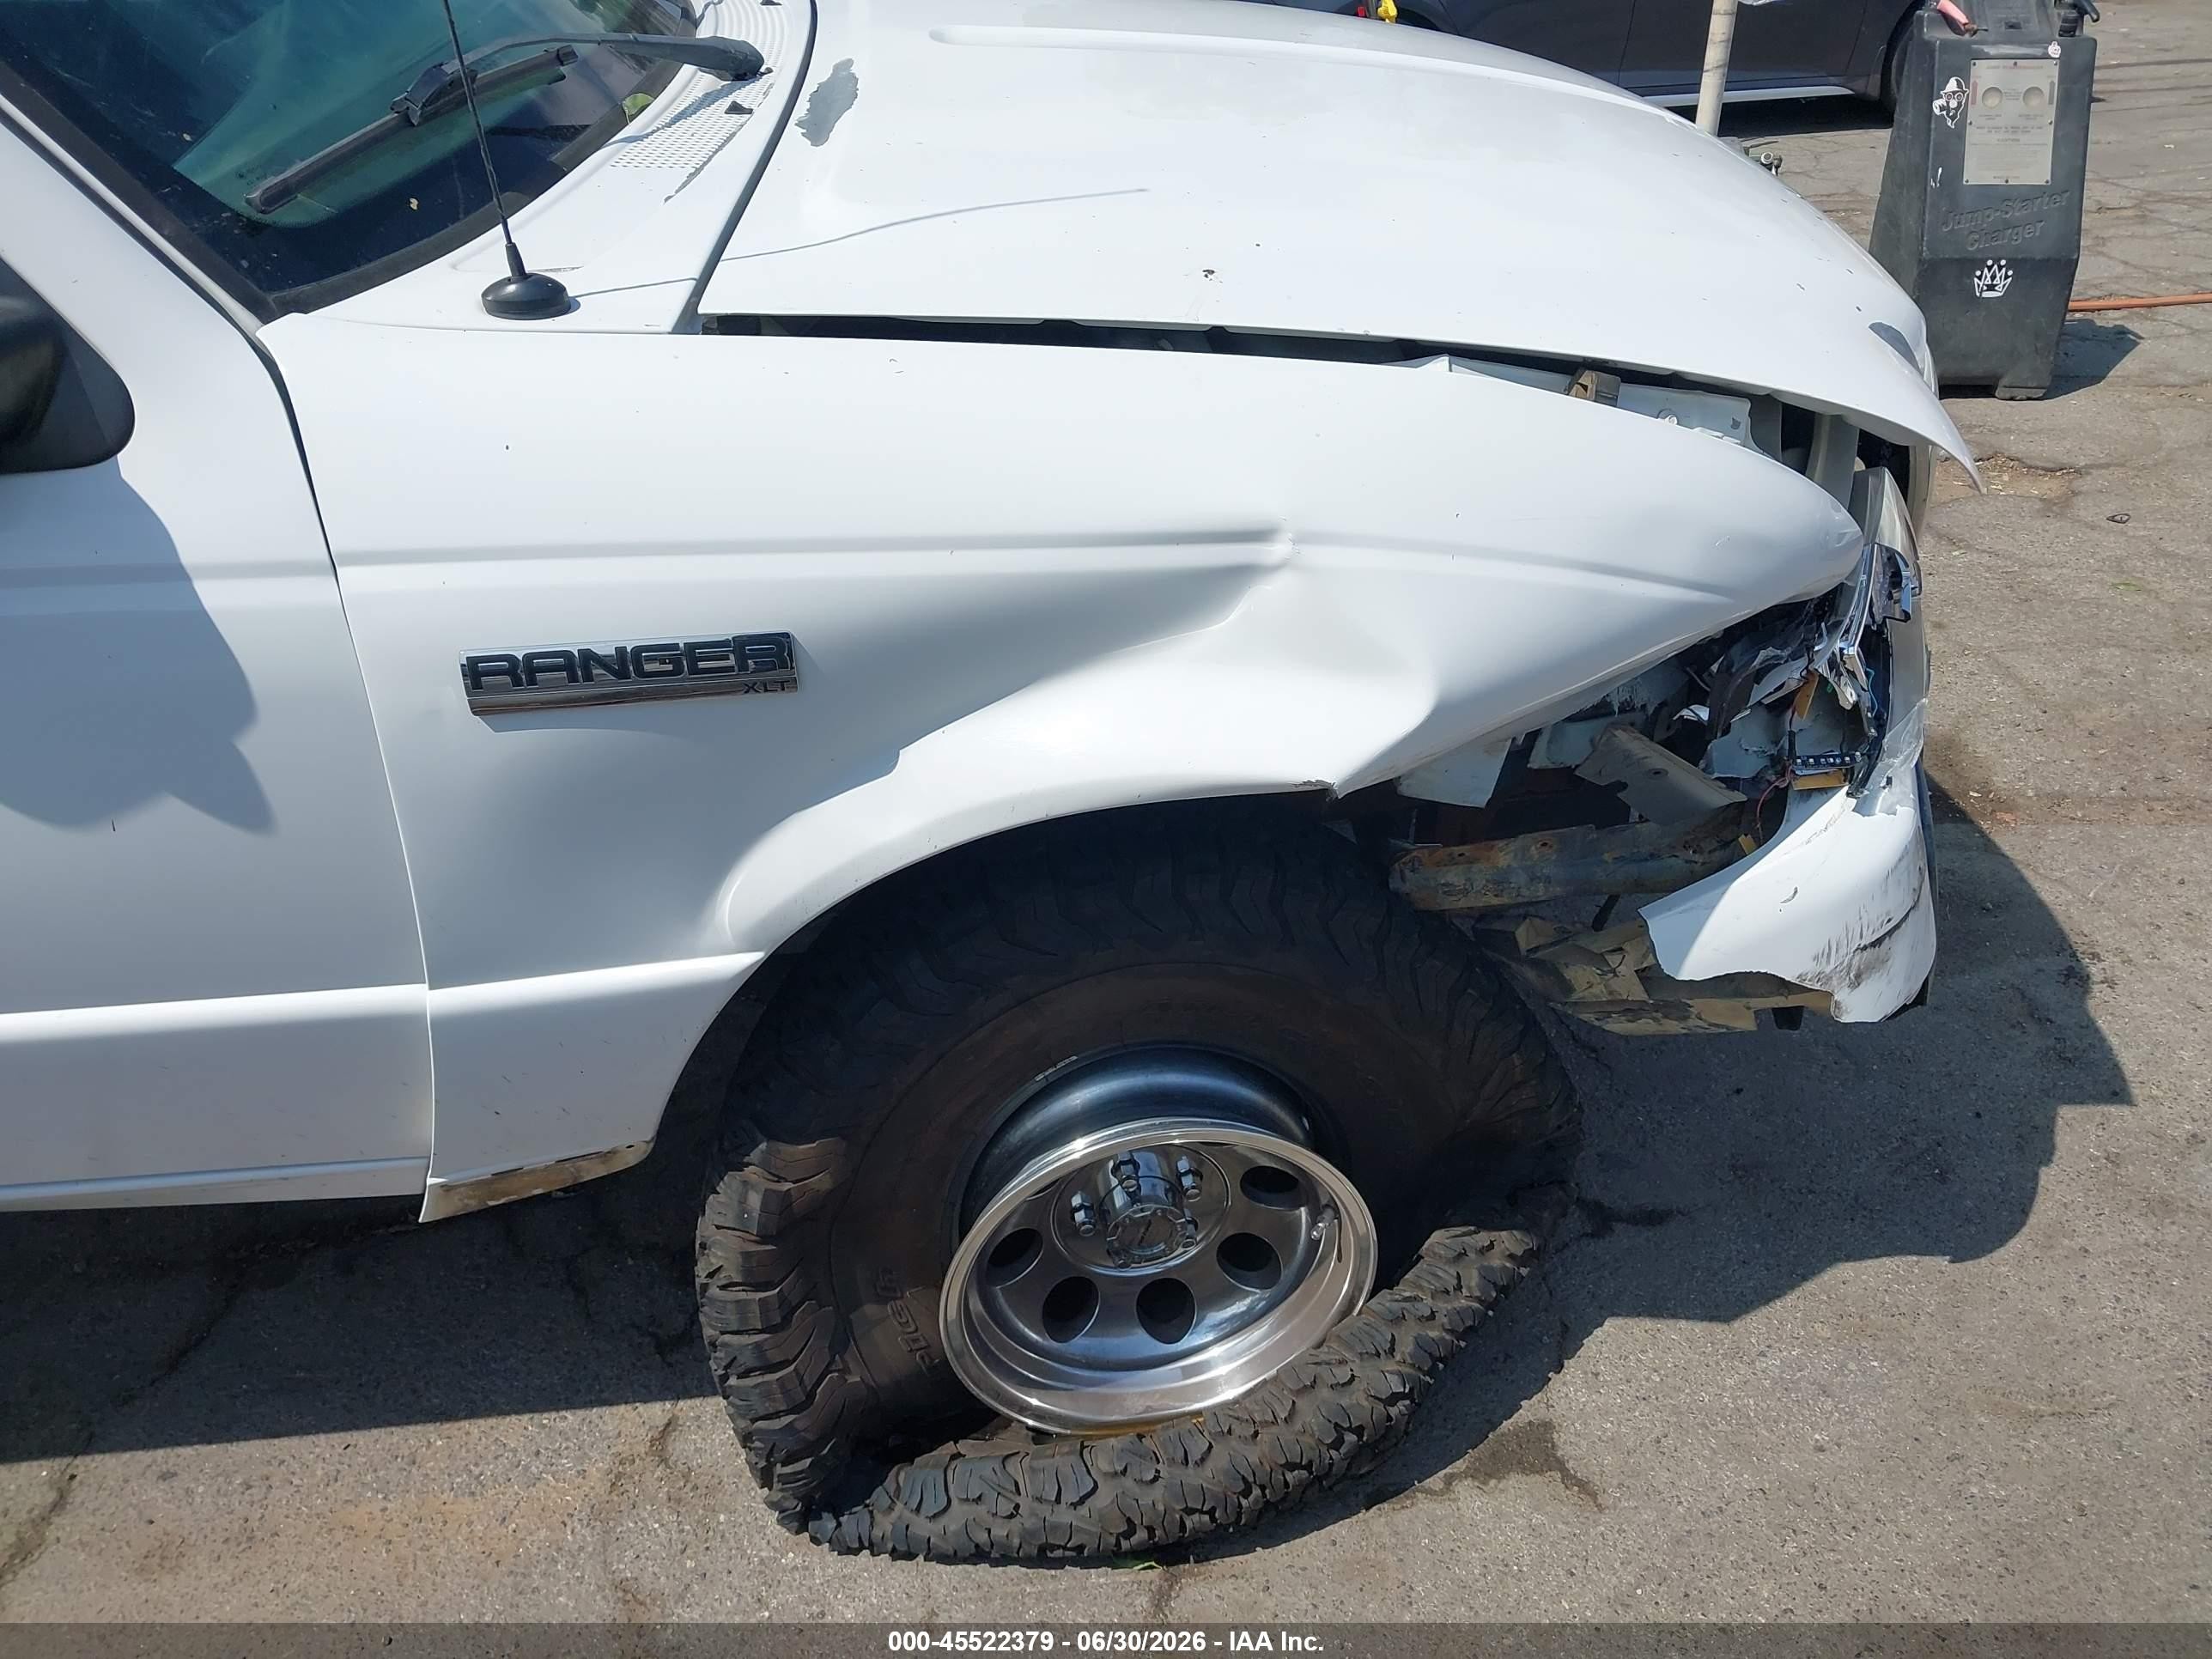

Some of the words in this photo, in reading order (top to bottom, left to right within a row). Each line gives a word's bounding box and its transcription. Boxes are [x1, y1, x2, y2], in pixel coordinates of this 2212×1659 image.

[1965, 219, 2045, 252] Charger
[465, 631, 791, 690] RANGER
[742, 678, 791, 695] XLT
